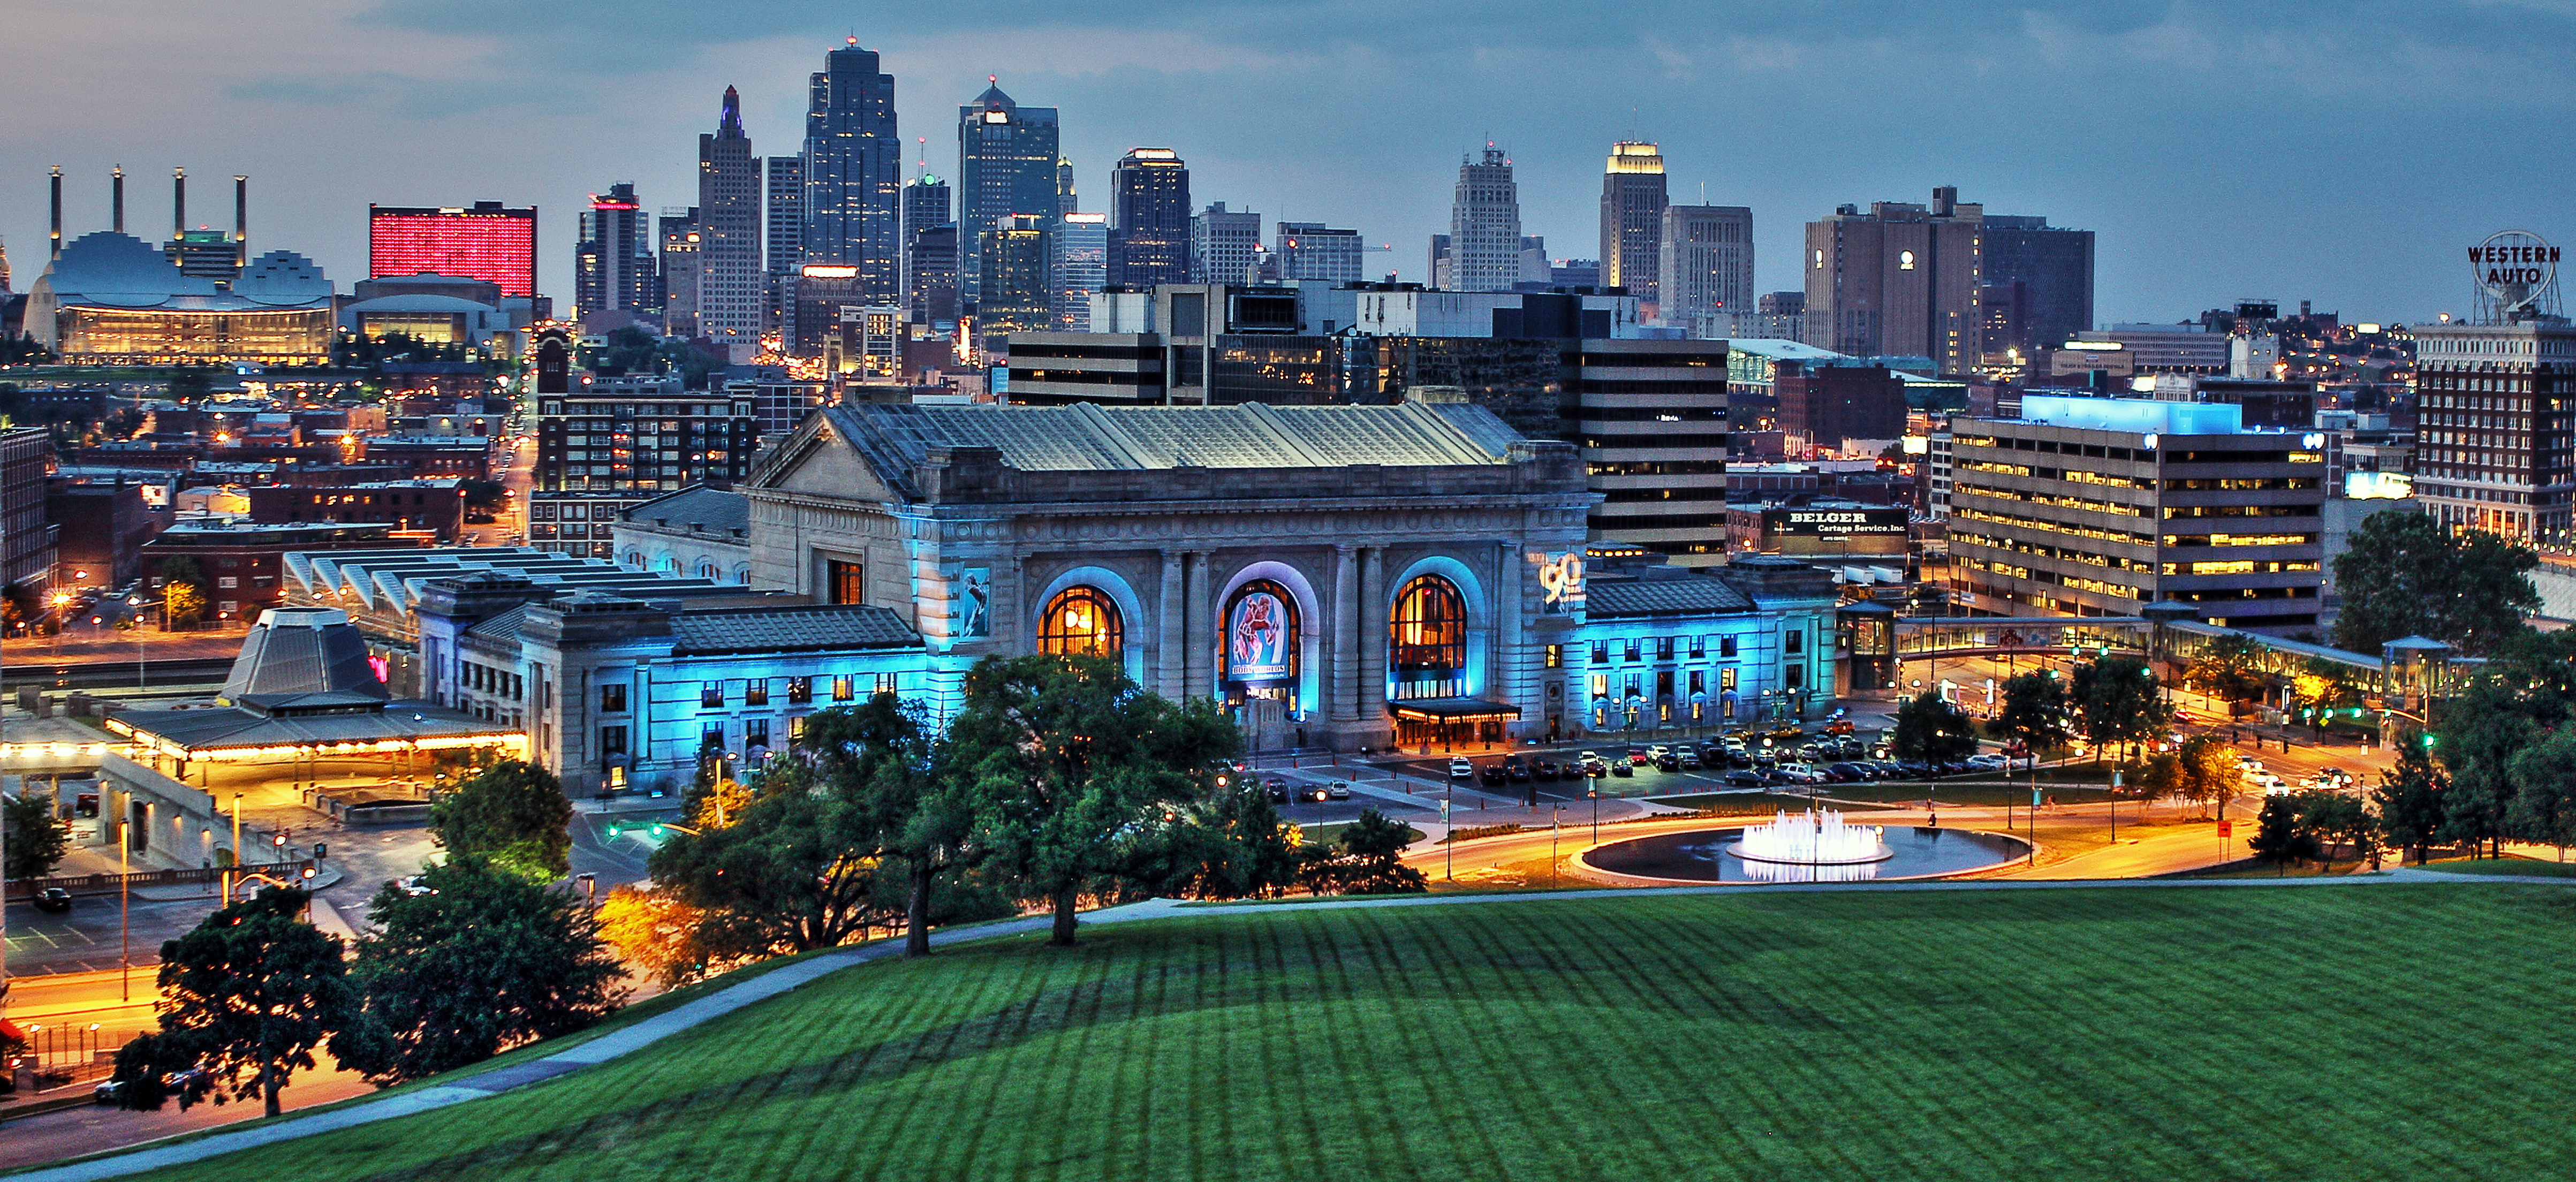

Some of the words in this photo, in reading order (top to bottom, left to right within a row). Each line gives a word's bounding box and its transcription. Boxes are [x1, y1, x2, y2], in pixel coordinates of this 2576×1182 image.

[2468, 247, 2560, 262] WESTERN
[2487, 268, 2541, 284] AUTO
[1790, 513, 1867, 522] BELGER
[1817, 525, 1852, 533] Cartage
